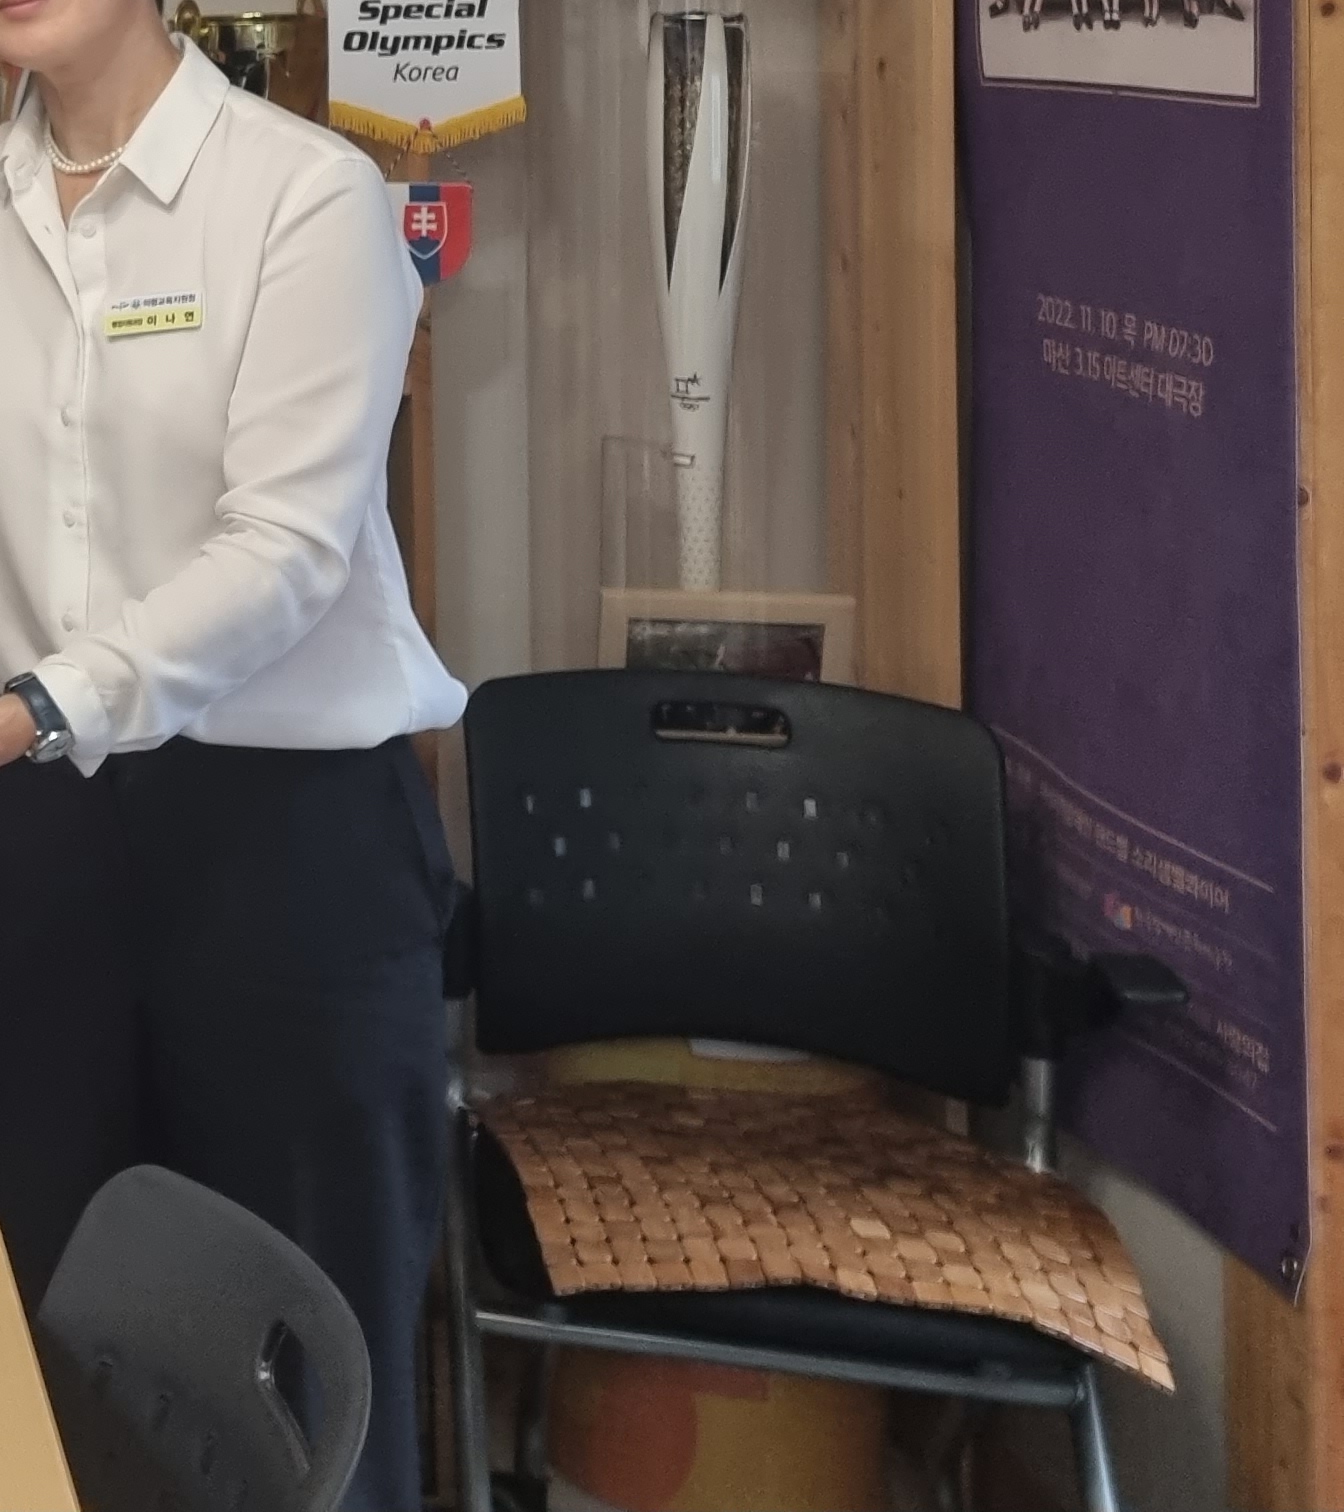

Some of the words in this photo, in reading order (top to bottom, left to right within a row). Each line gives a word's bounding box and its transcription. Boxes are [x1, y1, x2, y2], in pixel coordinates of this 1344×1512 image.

[343, 29, 507, 57] Olympics
[393, 62, 460, 83] Korea
[1123, 312, 1137, 350] 목
[1143, 319, 1165, 353] PM
[1042, 338, 1070, 375] 마산
[1157, 372, 1206, 418] 대극장
